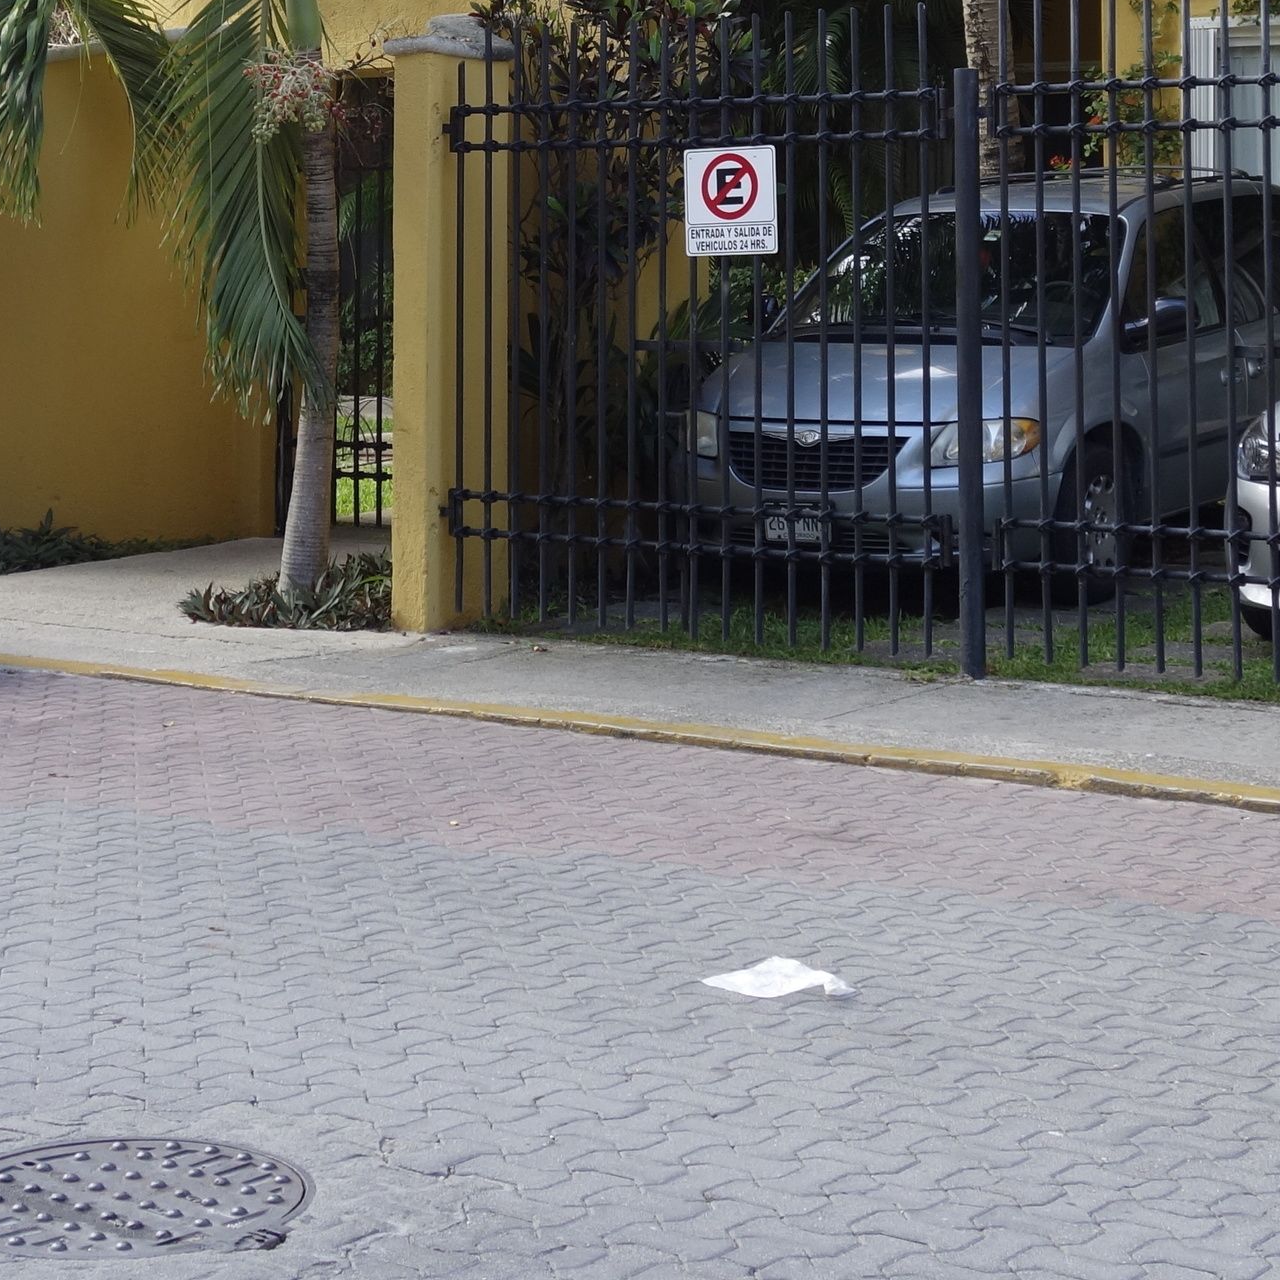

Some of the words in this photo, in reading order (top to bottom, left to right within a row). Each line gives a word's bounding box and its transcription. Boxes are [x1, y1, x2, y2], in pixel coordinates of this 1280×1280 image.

[690, 228, 726, 239] ENTRADA
[727, 228, 732, 238] Y
[734, 227, 761, 238] SALIDA
[763, 226, 773, 236] DE
[695, 241, 738, 251] VEHICULOS
[740, 240, 749, 250] 24
[750, 240, 768, 250] HRS.
